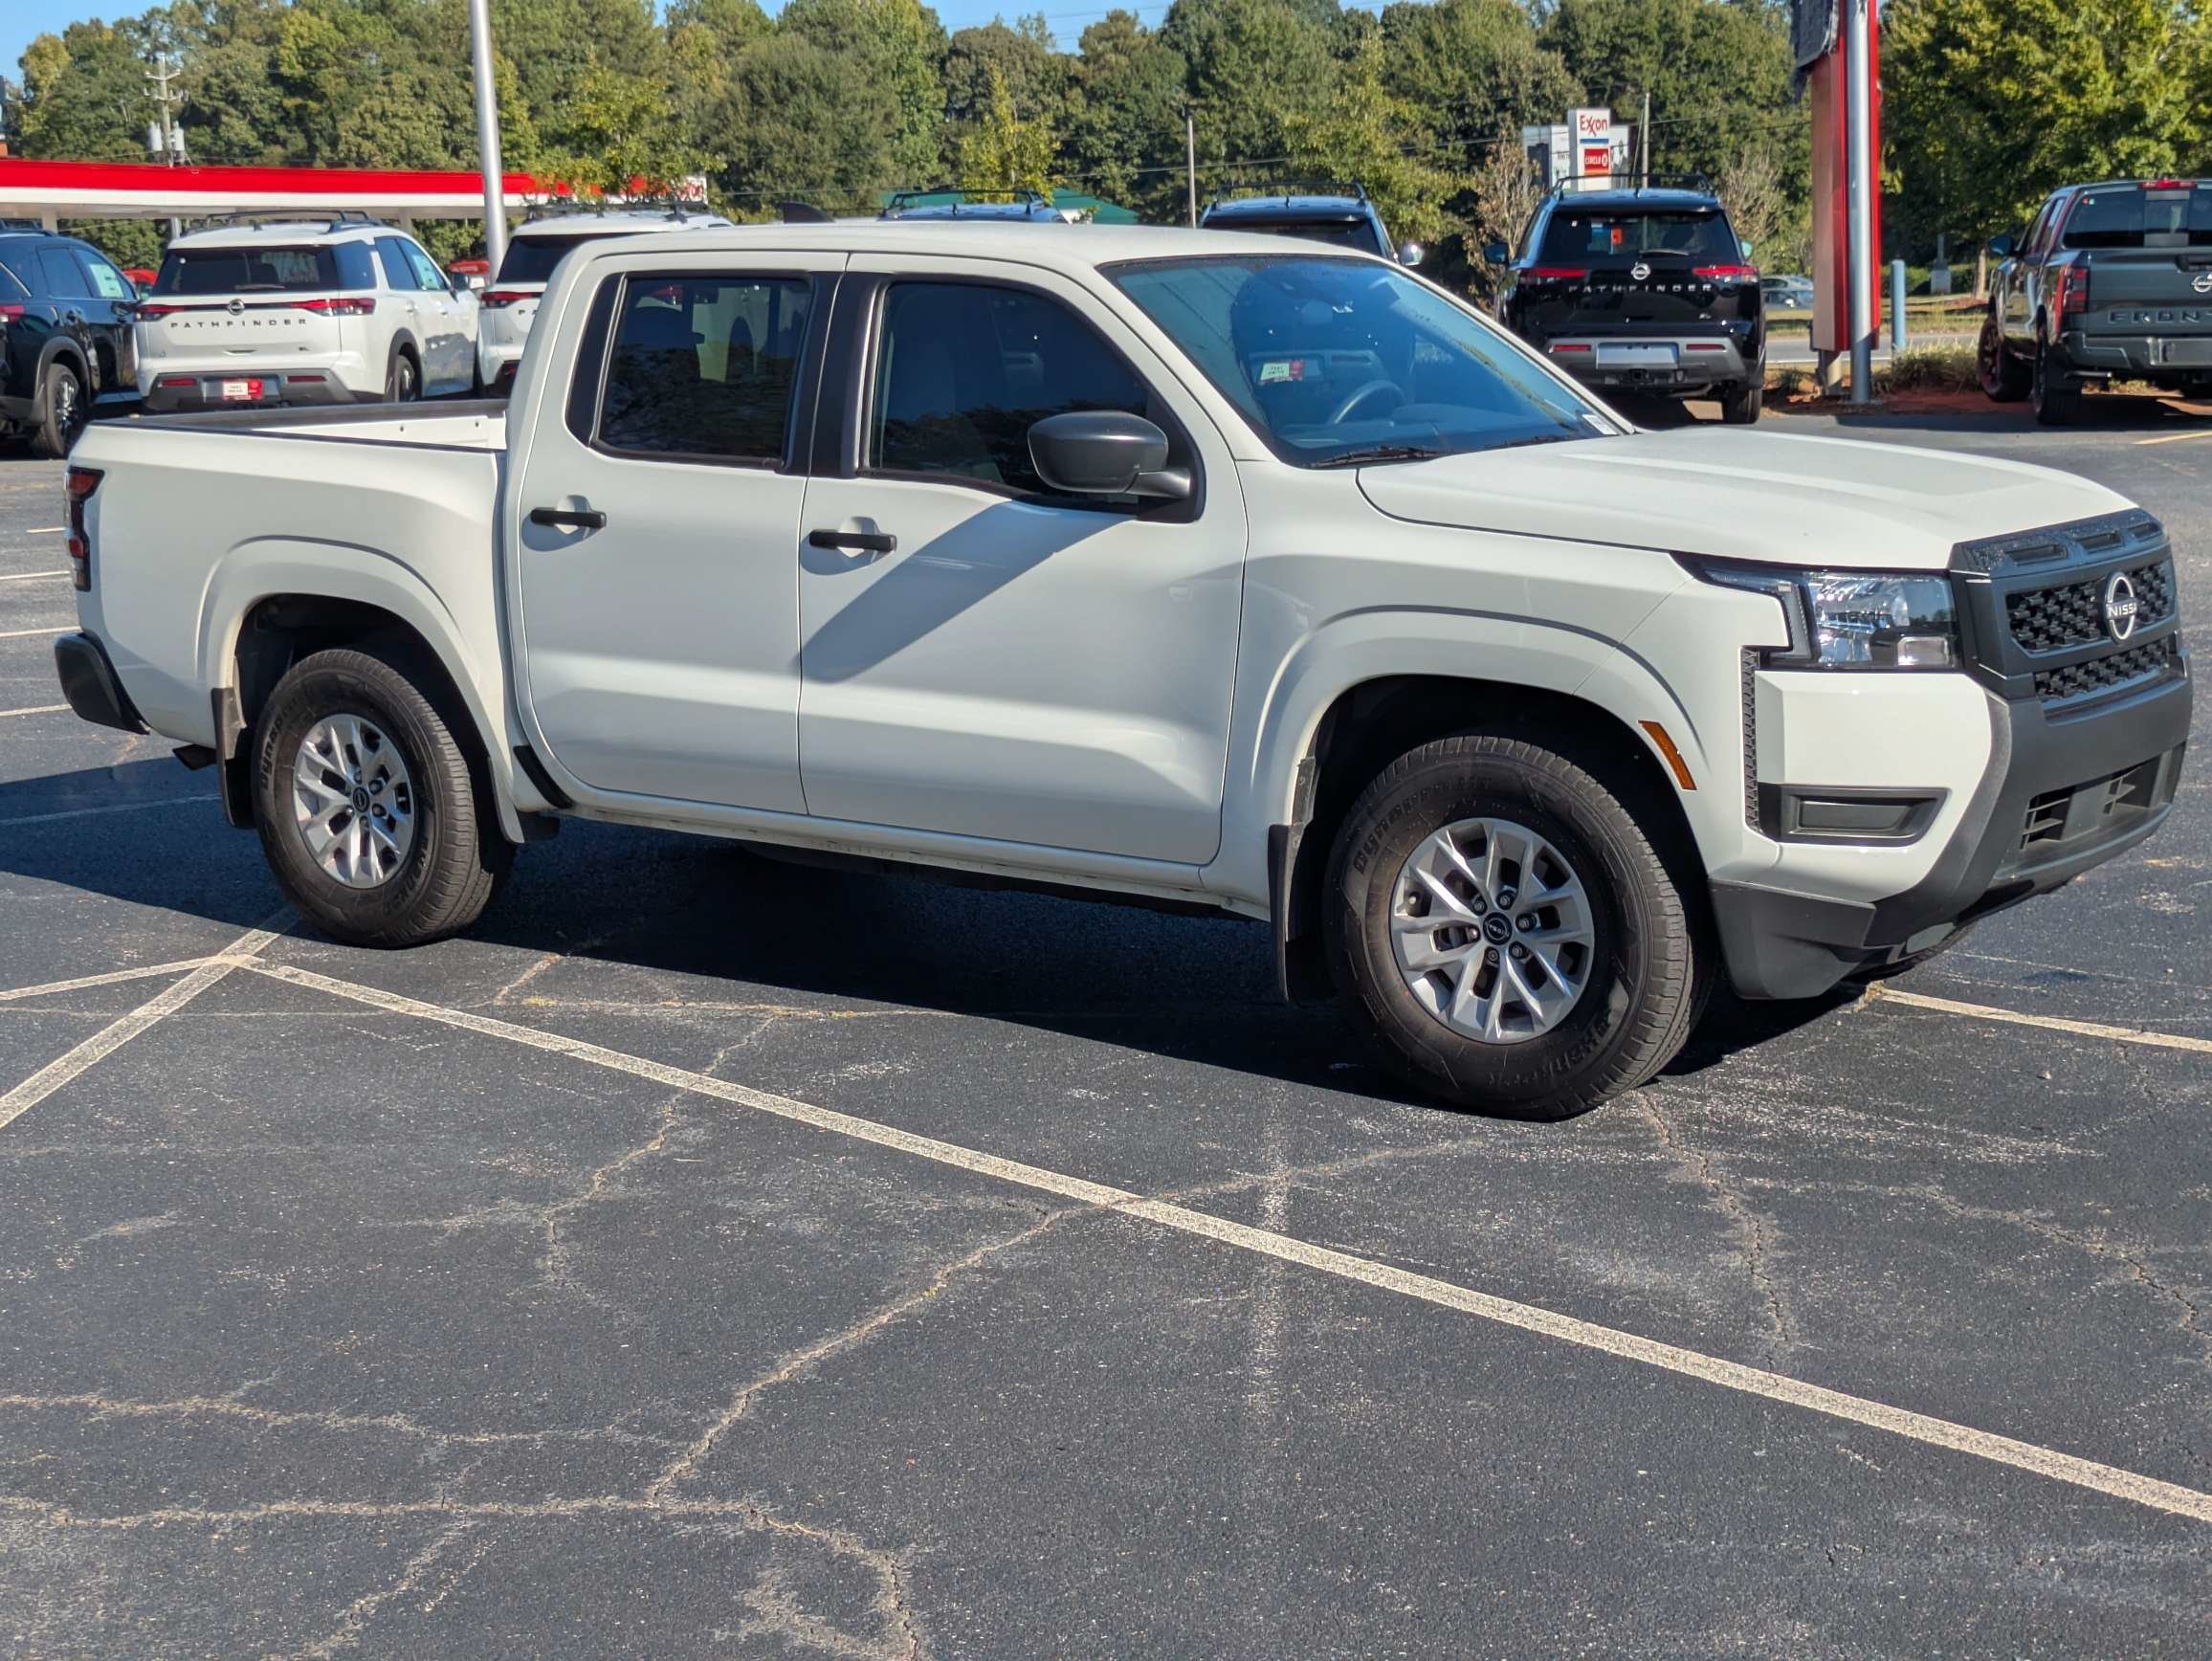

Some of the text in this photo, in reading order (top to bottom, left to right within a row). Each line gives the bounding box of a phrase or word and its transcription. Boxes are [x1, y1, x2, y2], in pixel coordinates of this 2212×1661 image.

[1580, 115, 1607, 137] Exxon
[1568, 284, 1712, 293] PATHFINDER
[170, 318, 306, 328] PATHFINDER
[2108, 602, 2136, 617] NISS
